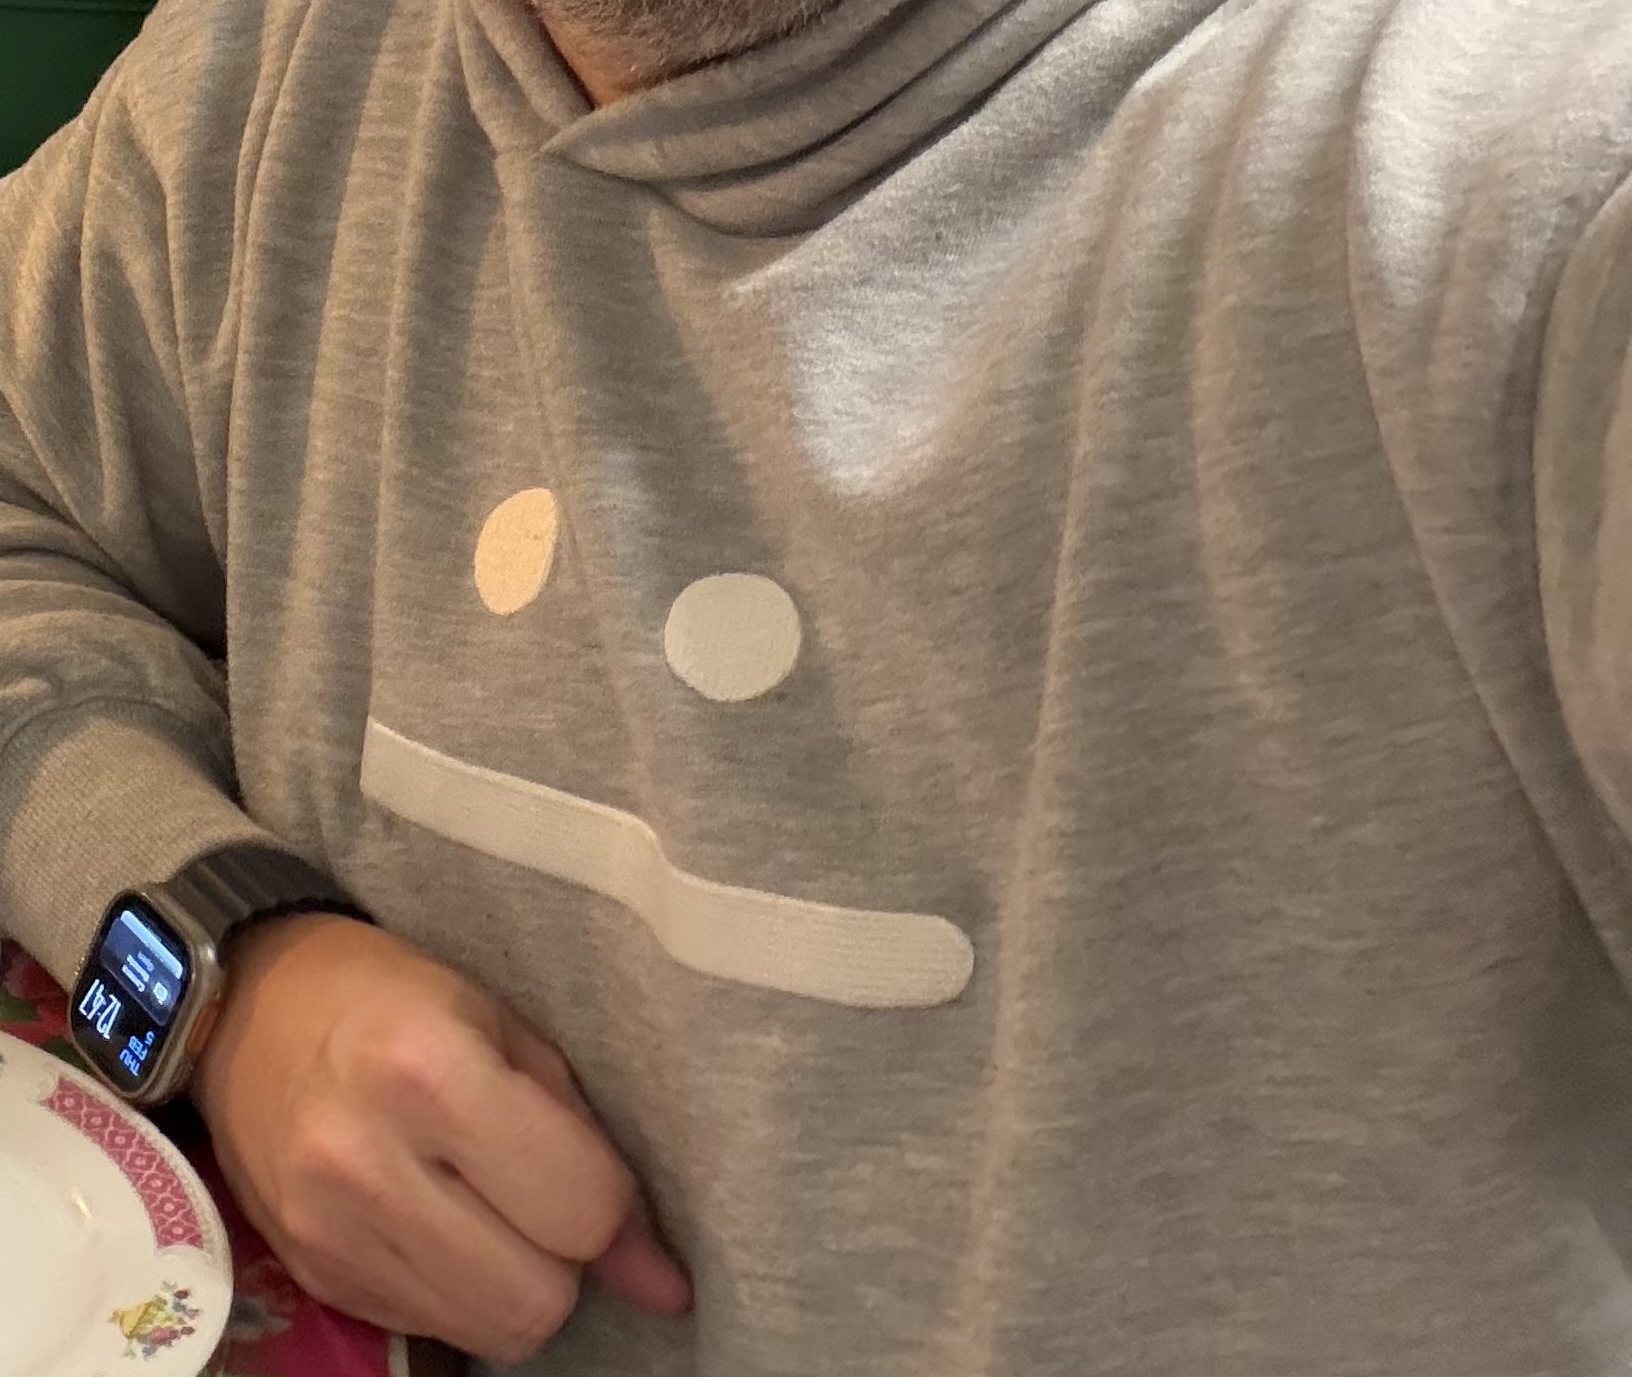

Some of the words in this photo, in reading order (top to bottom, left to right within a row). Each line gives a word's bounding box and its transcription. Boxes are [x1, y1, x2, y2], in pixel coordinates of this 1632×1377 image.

[78, 978, 122, 1040] 12:47
[128, 1035, 148, 1061] FEB
[145, 1030, 155, 1046] 5
[119, 1049, 140, 1076] THU
